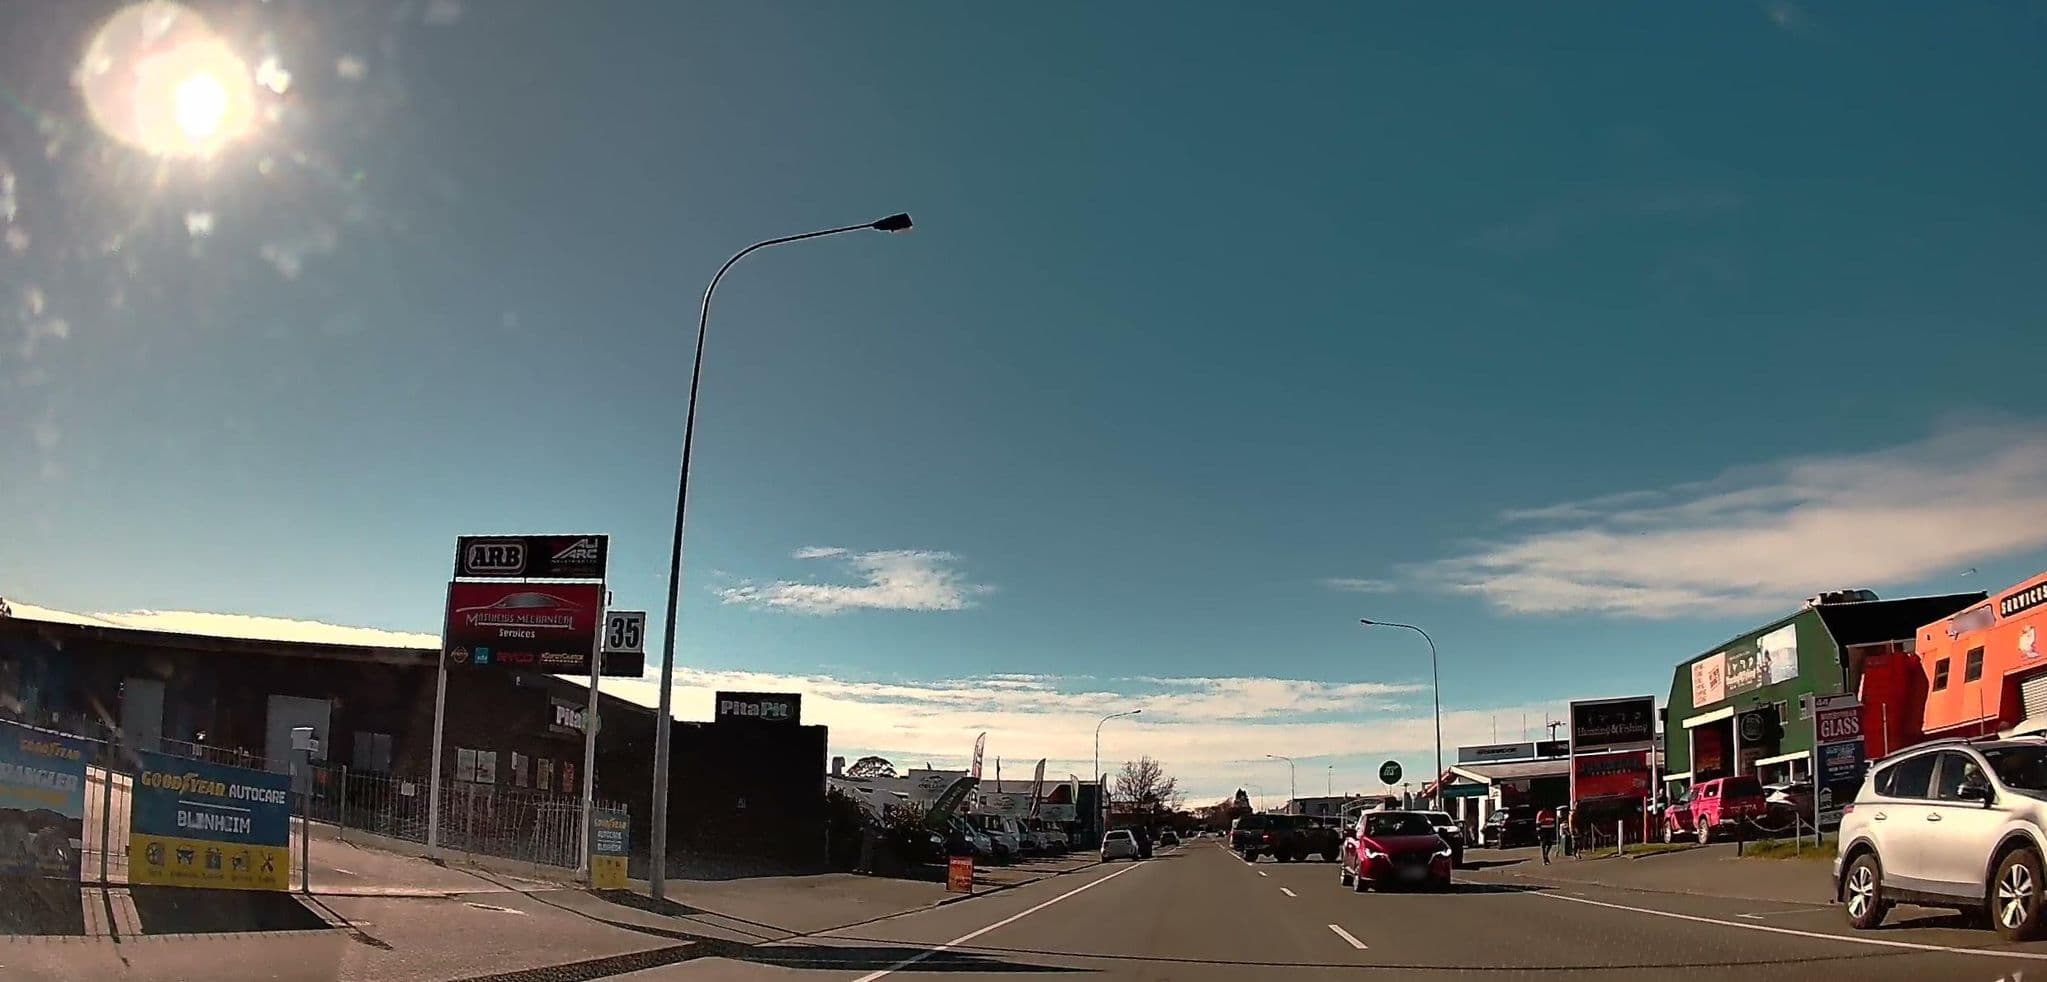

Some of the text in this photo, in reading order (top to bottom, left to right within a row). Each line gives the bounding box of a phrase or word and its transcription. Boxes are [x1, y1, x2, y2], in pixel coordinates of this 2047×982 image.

[470, 545, 522, 568] ARB
[499, 628, 536, 639] Services
[610, 618, 641, 648] 35
[1820, 716, 1860, 738] GLASS
[141, 771, 286, 804] GOODYEAR AUTOCARE
